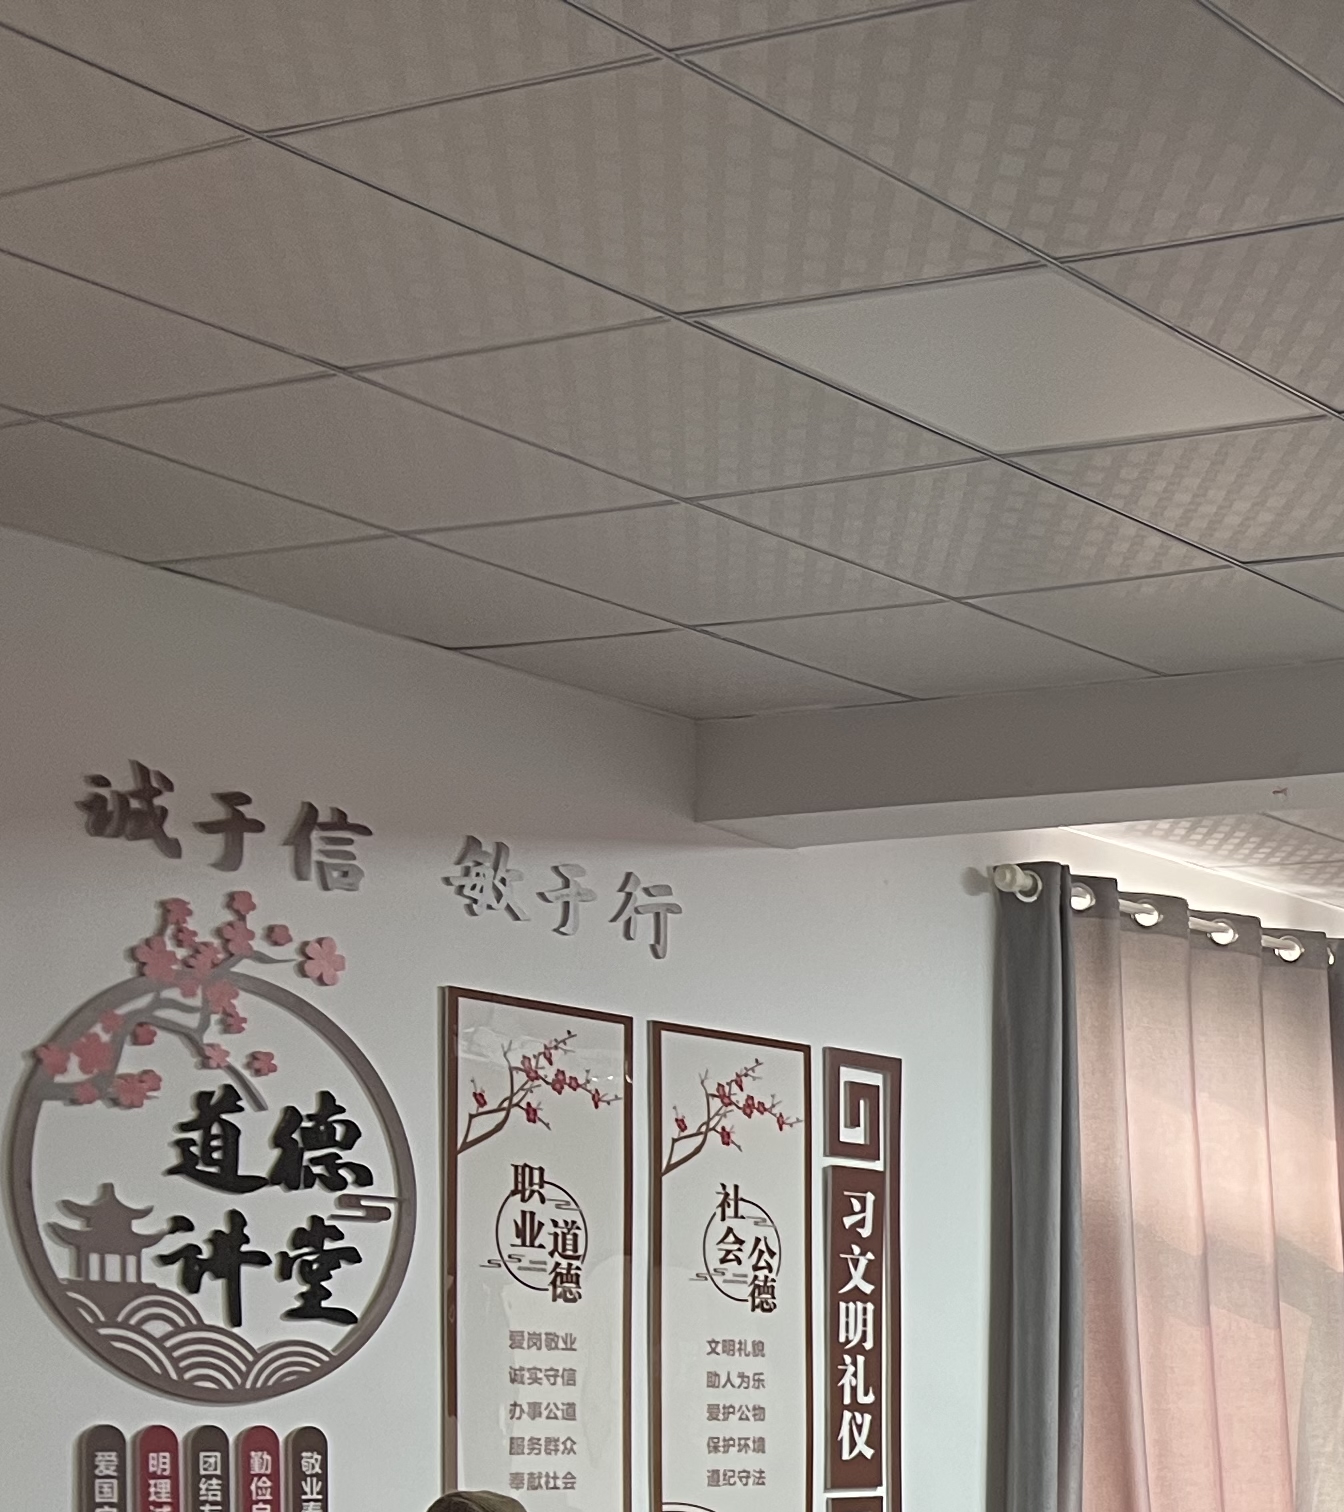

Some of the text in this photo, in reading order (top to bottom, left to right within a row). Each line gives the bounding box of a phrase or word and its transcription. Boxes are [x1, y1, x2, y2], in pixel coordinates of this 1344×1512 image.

[162, 1084, 374, 1194] 道德
[510, 1163, 546, 1250] 职业
[715, 1183, 746, 1266] 社会
[153, 1209, 362, 1328] 讲堂
[547, 1218, 582, 1303] 道德
[747, 1235, 777, 1314] 公德
[837, 1190, 876, 1461] 习文明礼仪
[508, 1330, 577, 1351] 爱岗敬业
[706, 1339, 766, 1358] 文明礼貌
[508, 1366, 577, 1387] 诚实守信
[706, 1371, 766, 1390] 助人为乐
[508, 1401, 577, 1422] 办事公道
[706, 1404, 766, 1422] 爱护公物
[508, 1435, 577, 1456] 服务群众
[706, 1436, 766, 1455] 保护环境
[508, 1471, 577, 1491] 奉献社会
[706, 1468, 766, 1487] 遵纪守法
